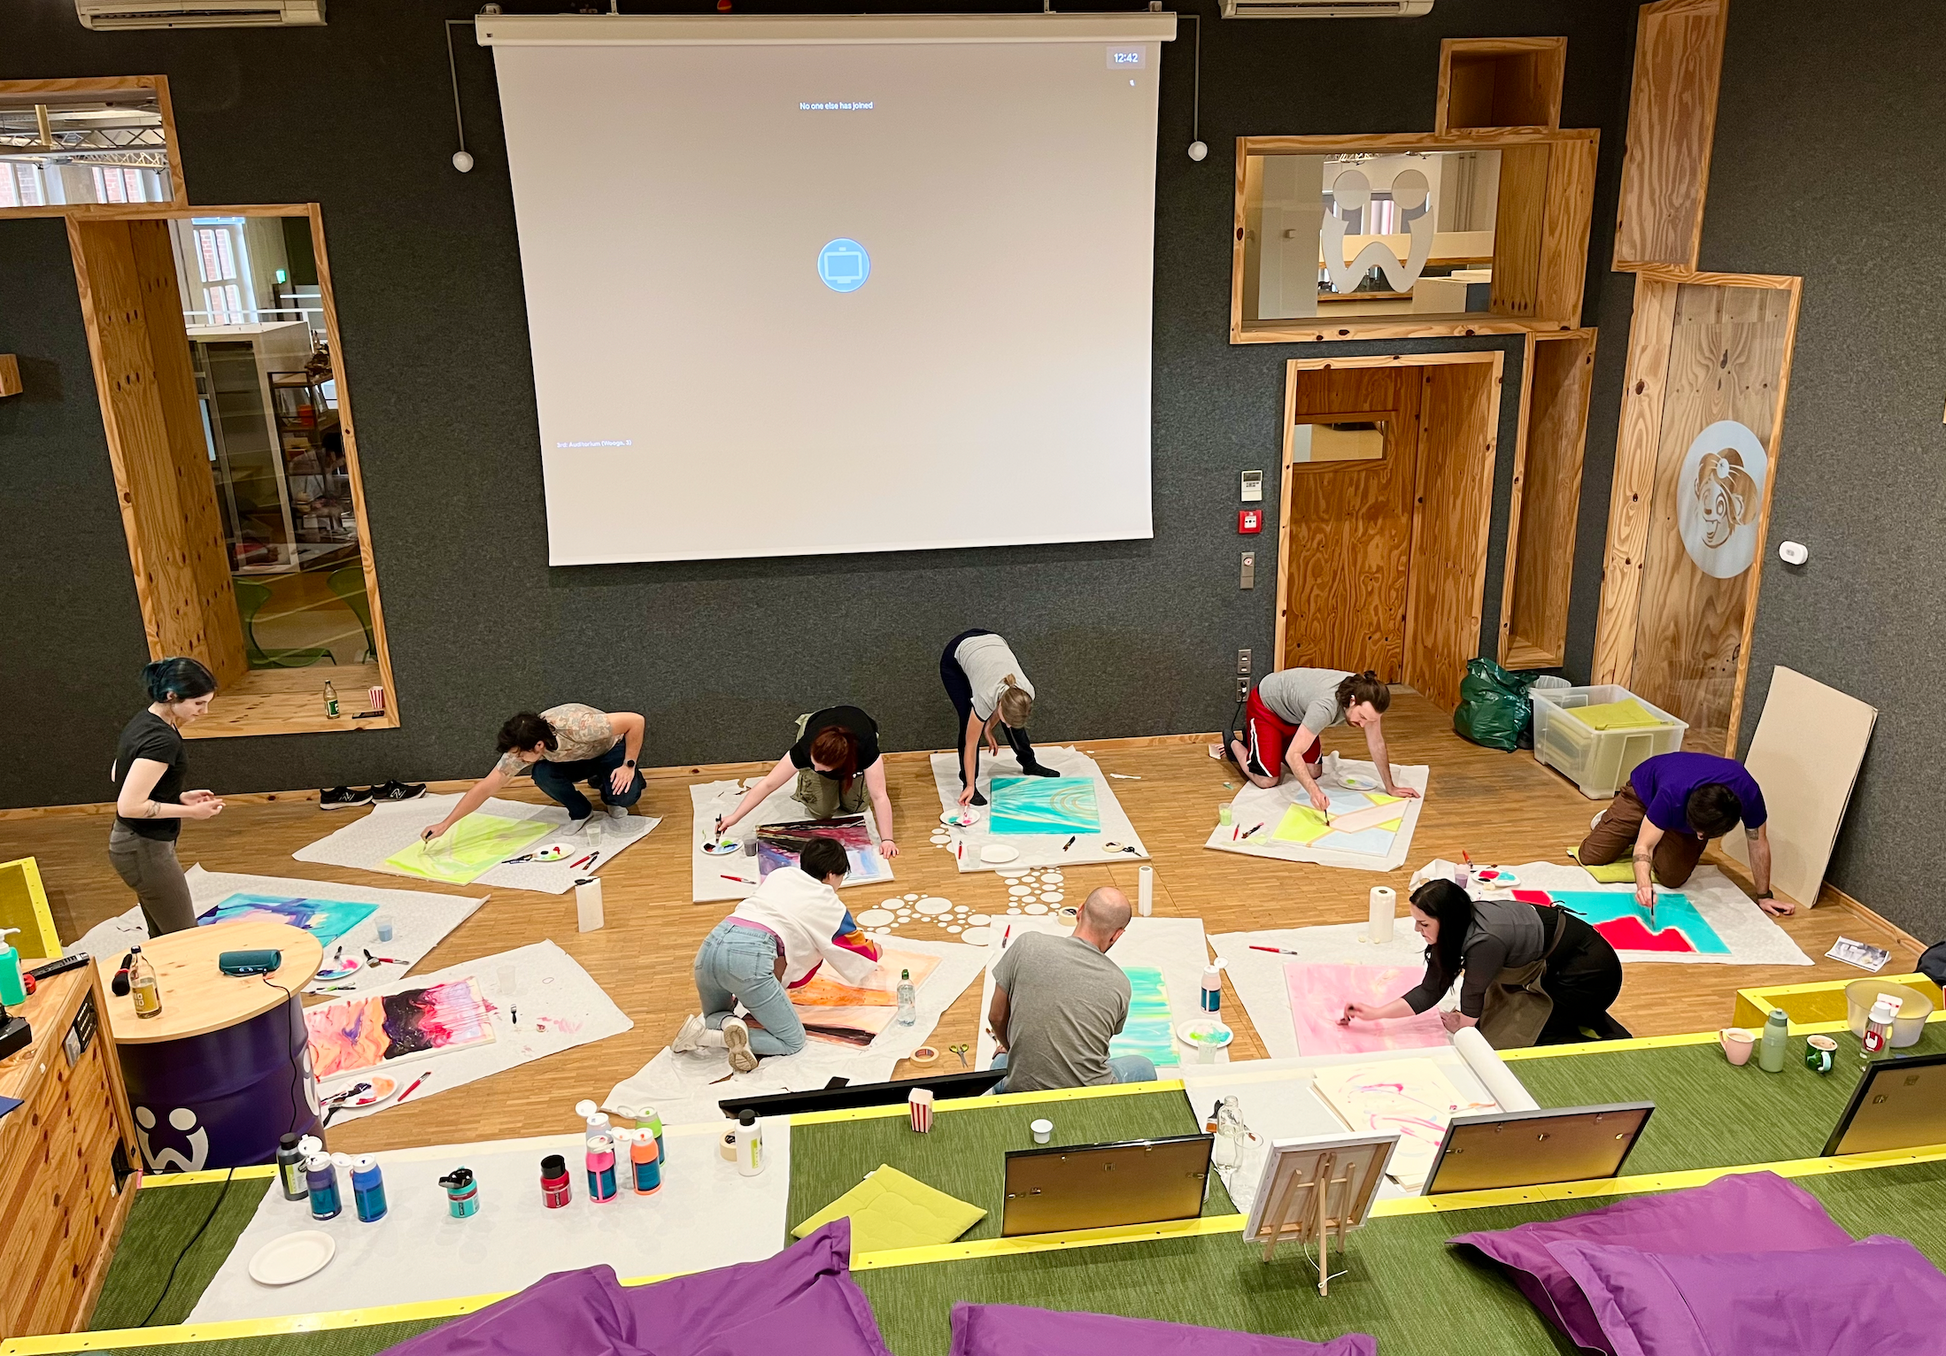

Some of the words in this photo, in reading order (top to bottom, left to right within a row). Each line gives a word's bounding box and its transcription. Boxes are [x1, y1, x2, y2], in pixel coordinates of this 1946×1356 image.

[1114, 53, 1138, 63] 12:42
[799, 102, 810, 110] No
[825, 102, 839, 110] else
[839, 102, 852, 110] has
[852, 101, 873, 111] joined
